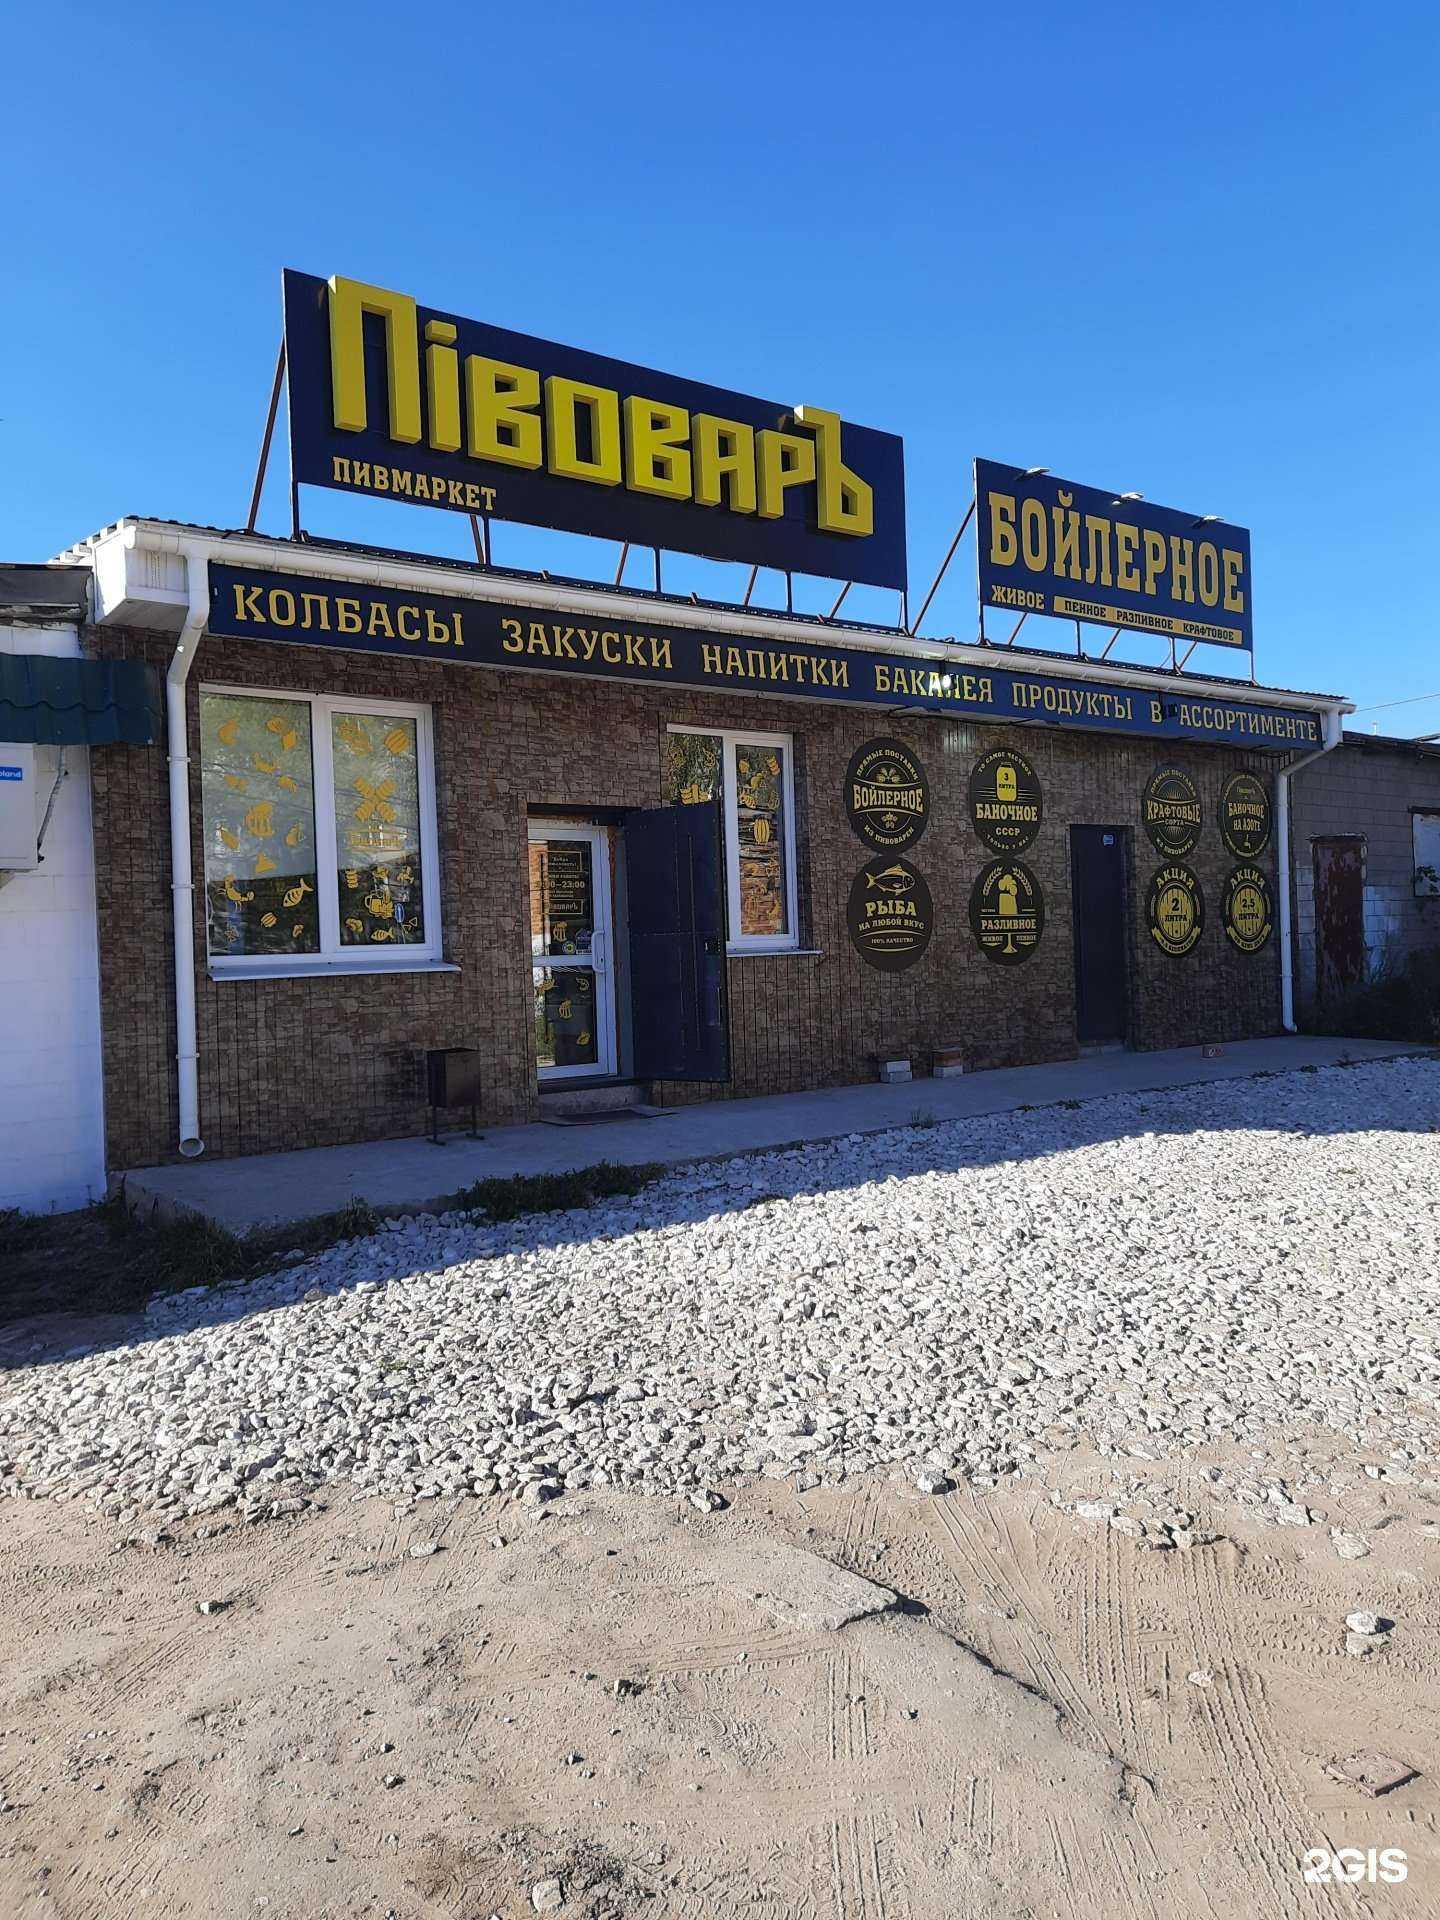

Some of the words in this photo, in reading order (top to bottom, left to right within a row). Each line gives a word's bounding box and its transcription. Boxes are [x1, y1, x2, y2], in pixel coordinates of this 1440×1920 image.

[332, 456, 497, 511] ПИВМАРКЕТ
[988, 489, 1244, 613] БОЙЛЕРНОЕ
[991, 585, 1045, 610] ЖИВОЕ
[1064, 600, 1106, 618] ПЕННОЕ
[1116, 611, 1173, 630] РАЗЛИВНОЕ
[1183, 623, 1234, 641] КРАФТОВОЕ
[233, 584, 465, 646] КОЛБАСЫ
[501, 618, 672, 669] ЗАКУСКИ
[702, 644, 849, 688] НАПИТКИ
[1012, 683, 1133, 720] ПРОДУКТЫ
[1151, 700, 1162, 723] В
[1180, 706, 1317, 741] АССОРТИМЕНТЕ
[1004, 772, 1009, 781] 3
[853, 784, 923, 813] БОЙЛЕРНОЕ
[976, 803, 1037, 821] БАНОЧНОЕ
[1147, 800, 1200, 823] КРАФТОВЫЕ
[1228, 802, 1264, 819] БАНОЧНОЕ
[995, 827, 1020, 836] СССР
[1156, 868, 1194, 889] АКЦИЯ
[1230, 868, 1265, 890] АКЦИЯ
[865, 900, 916, 917] РЫБА
[1171, 898, 1179, 911] 2
[1242, 898, 1255, 909] 2,5
[858, 921, 870, 931] НА
[872, 916, 902, 927] ЛЮБОЙ
[904, 918, 924, 929] ВКУС
[981, 919, 1037, 930] РАЗЛИВНОЕ
[1165, 914, 1187, 922] ЛИТРА
